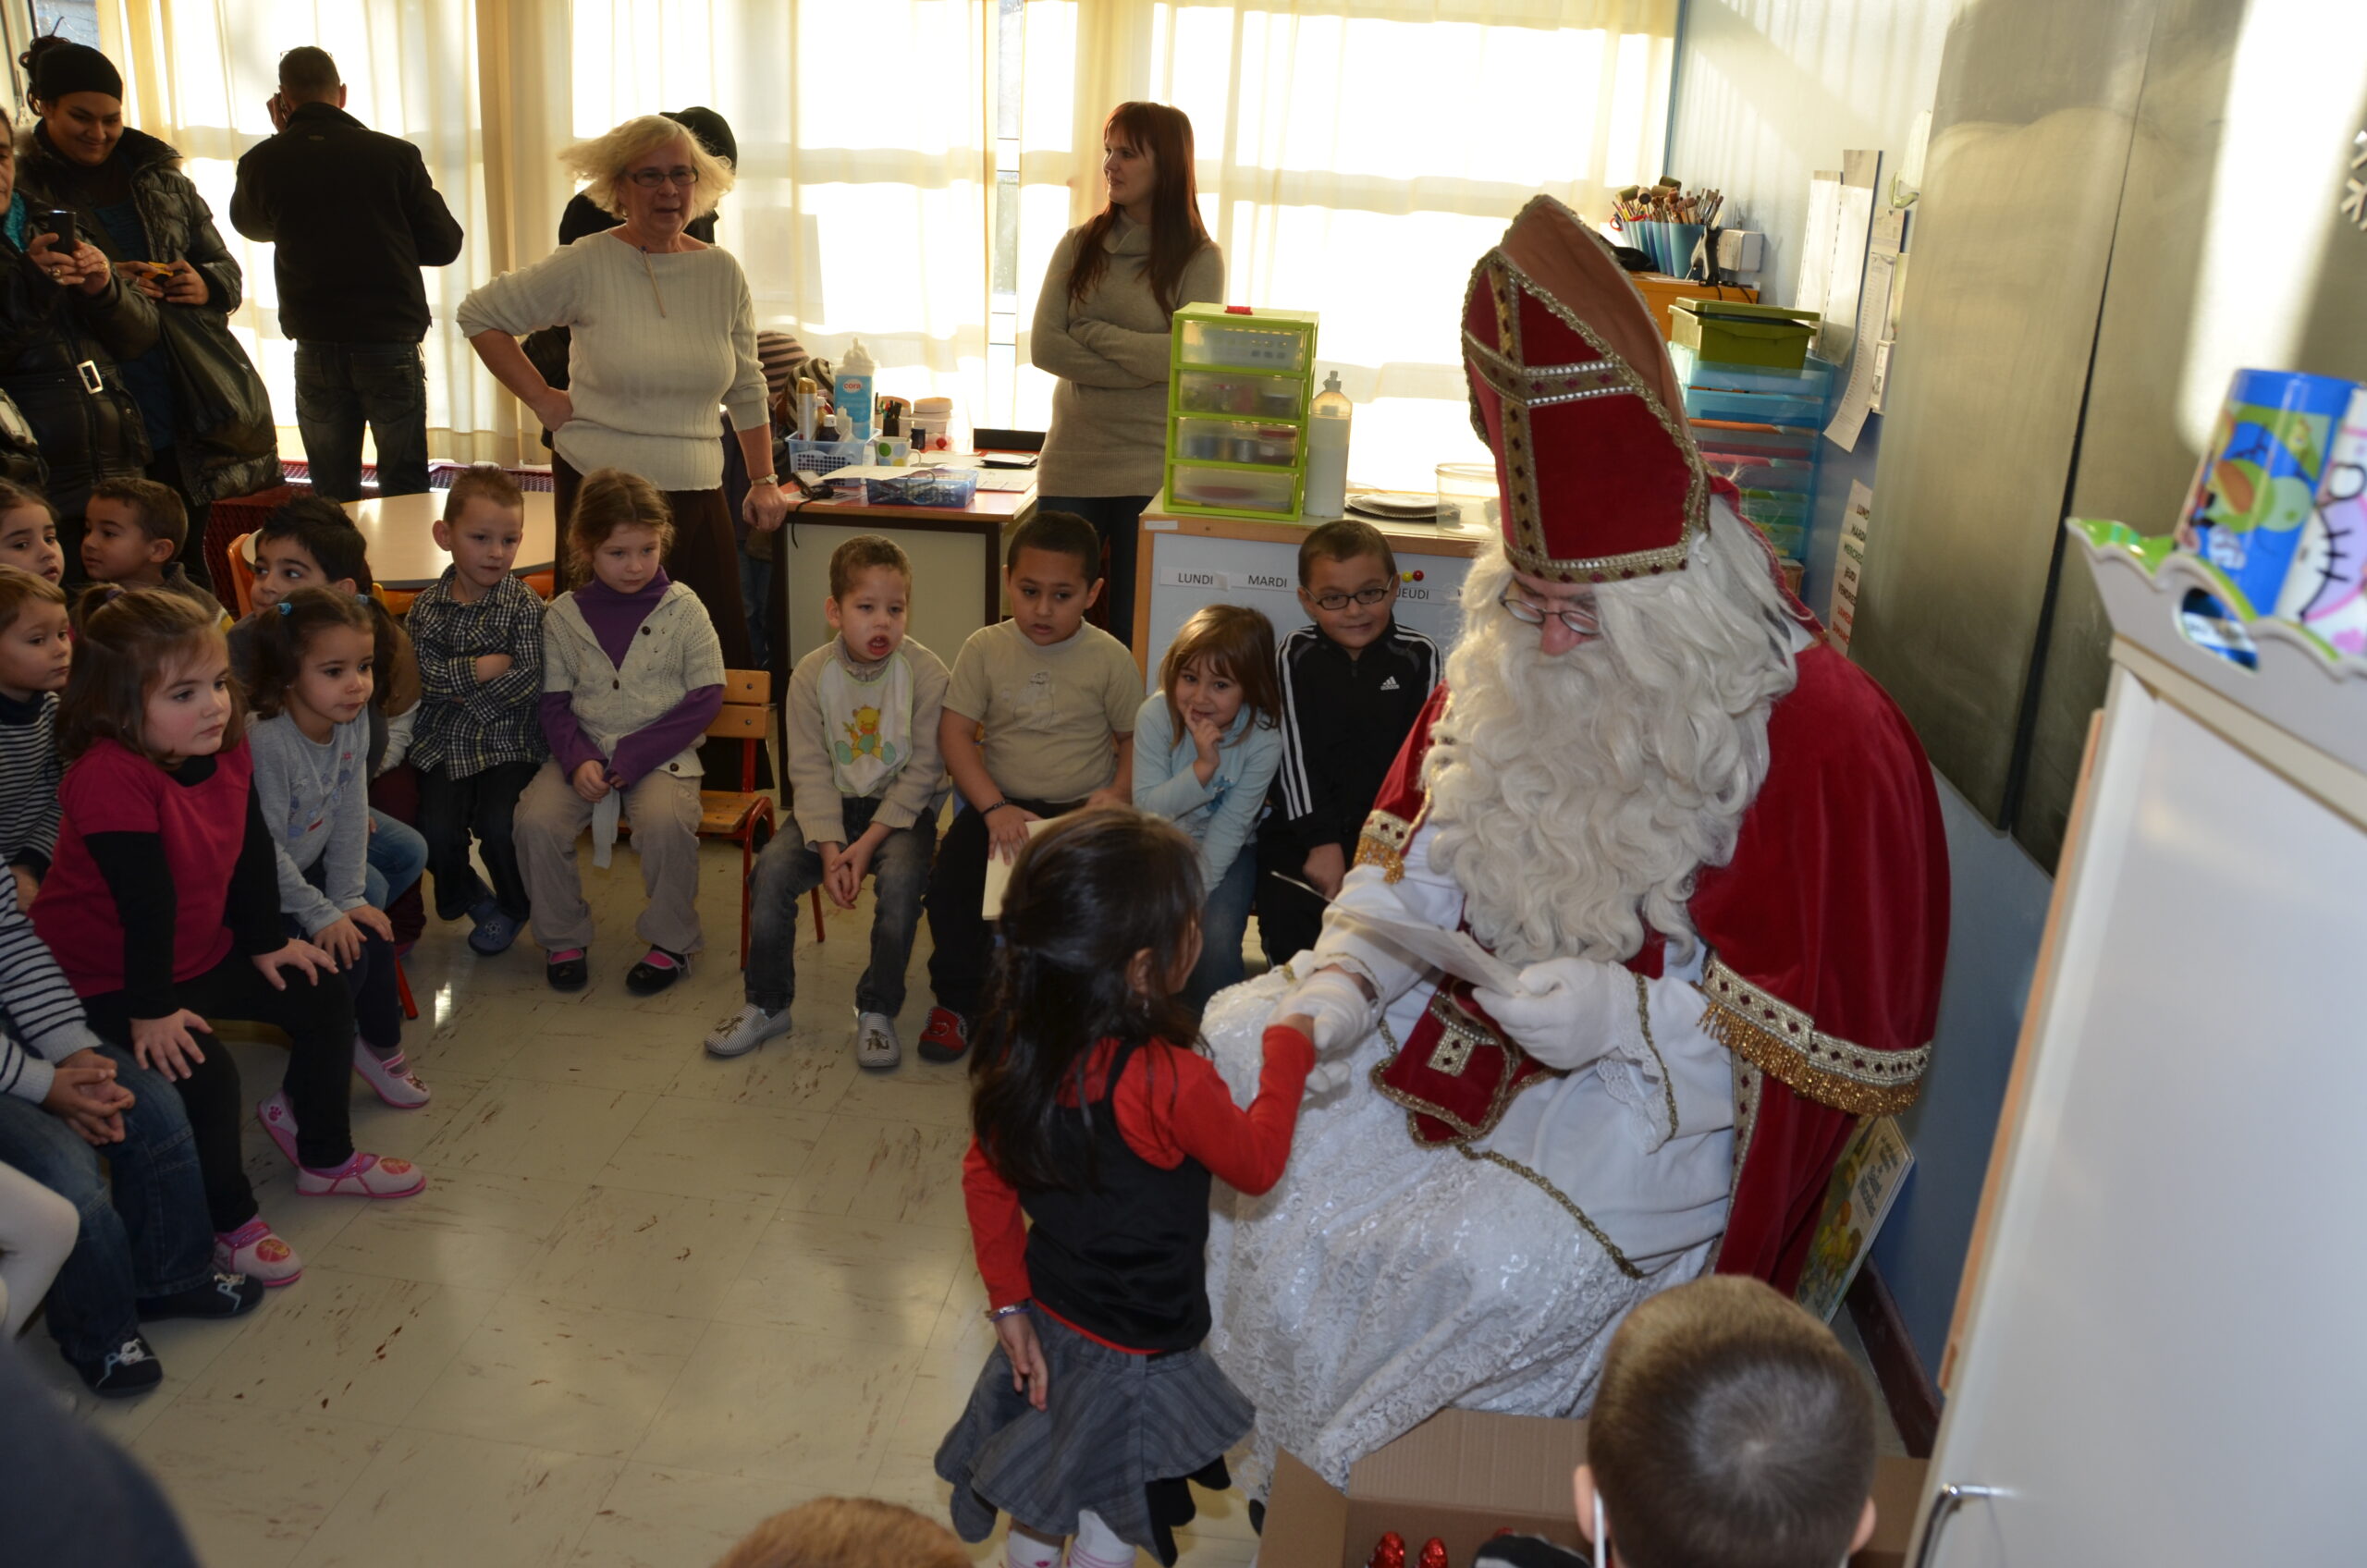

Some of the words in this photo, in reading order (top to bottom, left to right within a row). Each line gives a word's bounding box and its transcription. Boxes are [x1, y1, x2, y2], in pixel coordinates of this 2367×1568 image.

[1857, 504, 1870, 520] LUND
[1178, 572, 1213, 584] LUNDI
[1247, 574, 1287, 587] MARDI
[1394, 588, 1429, 599] JEUDI
